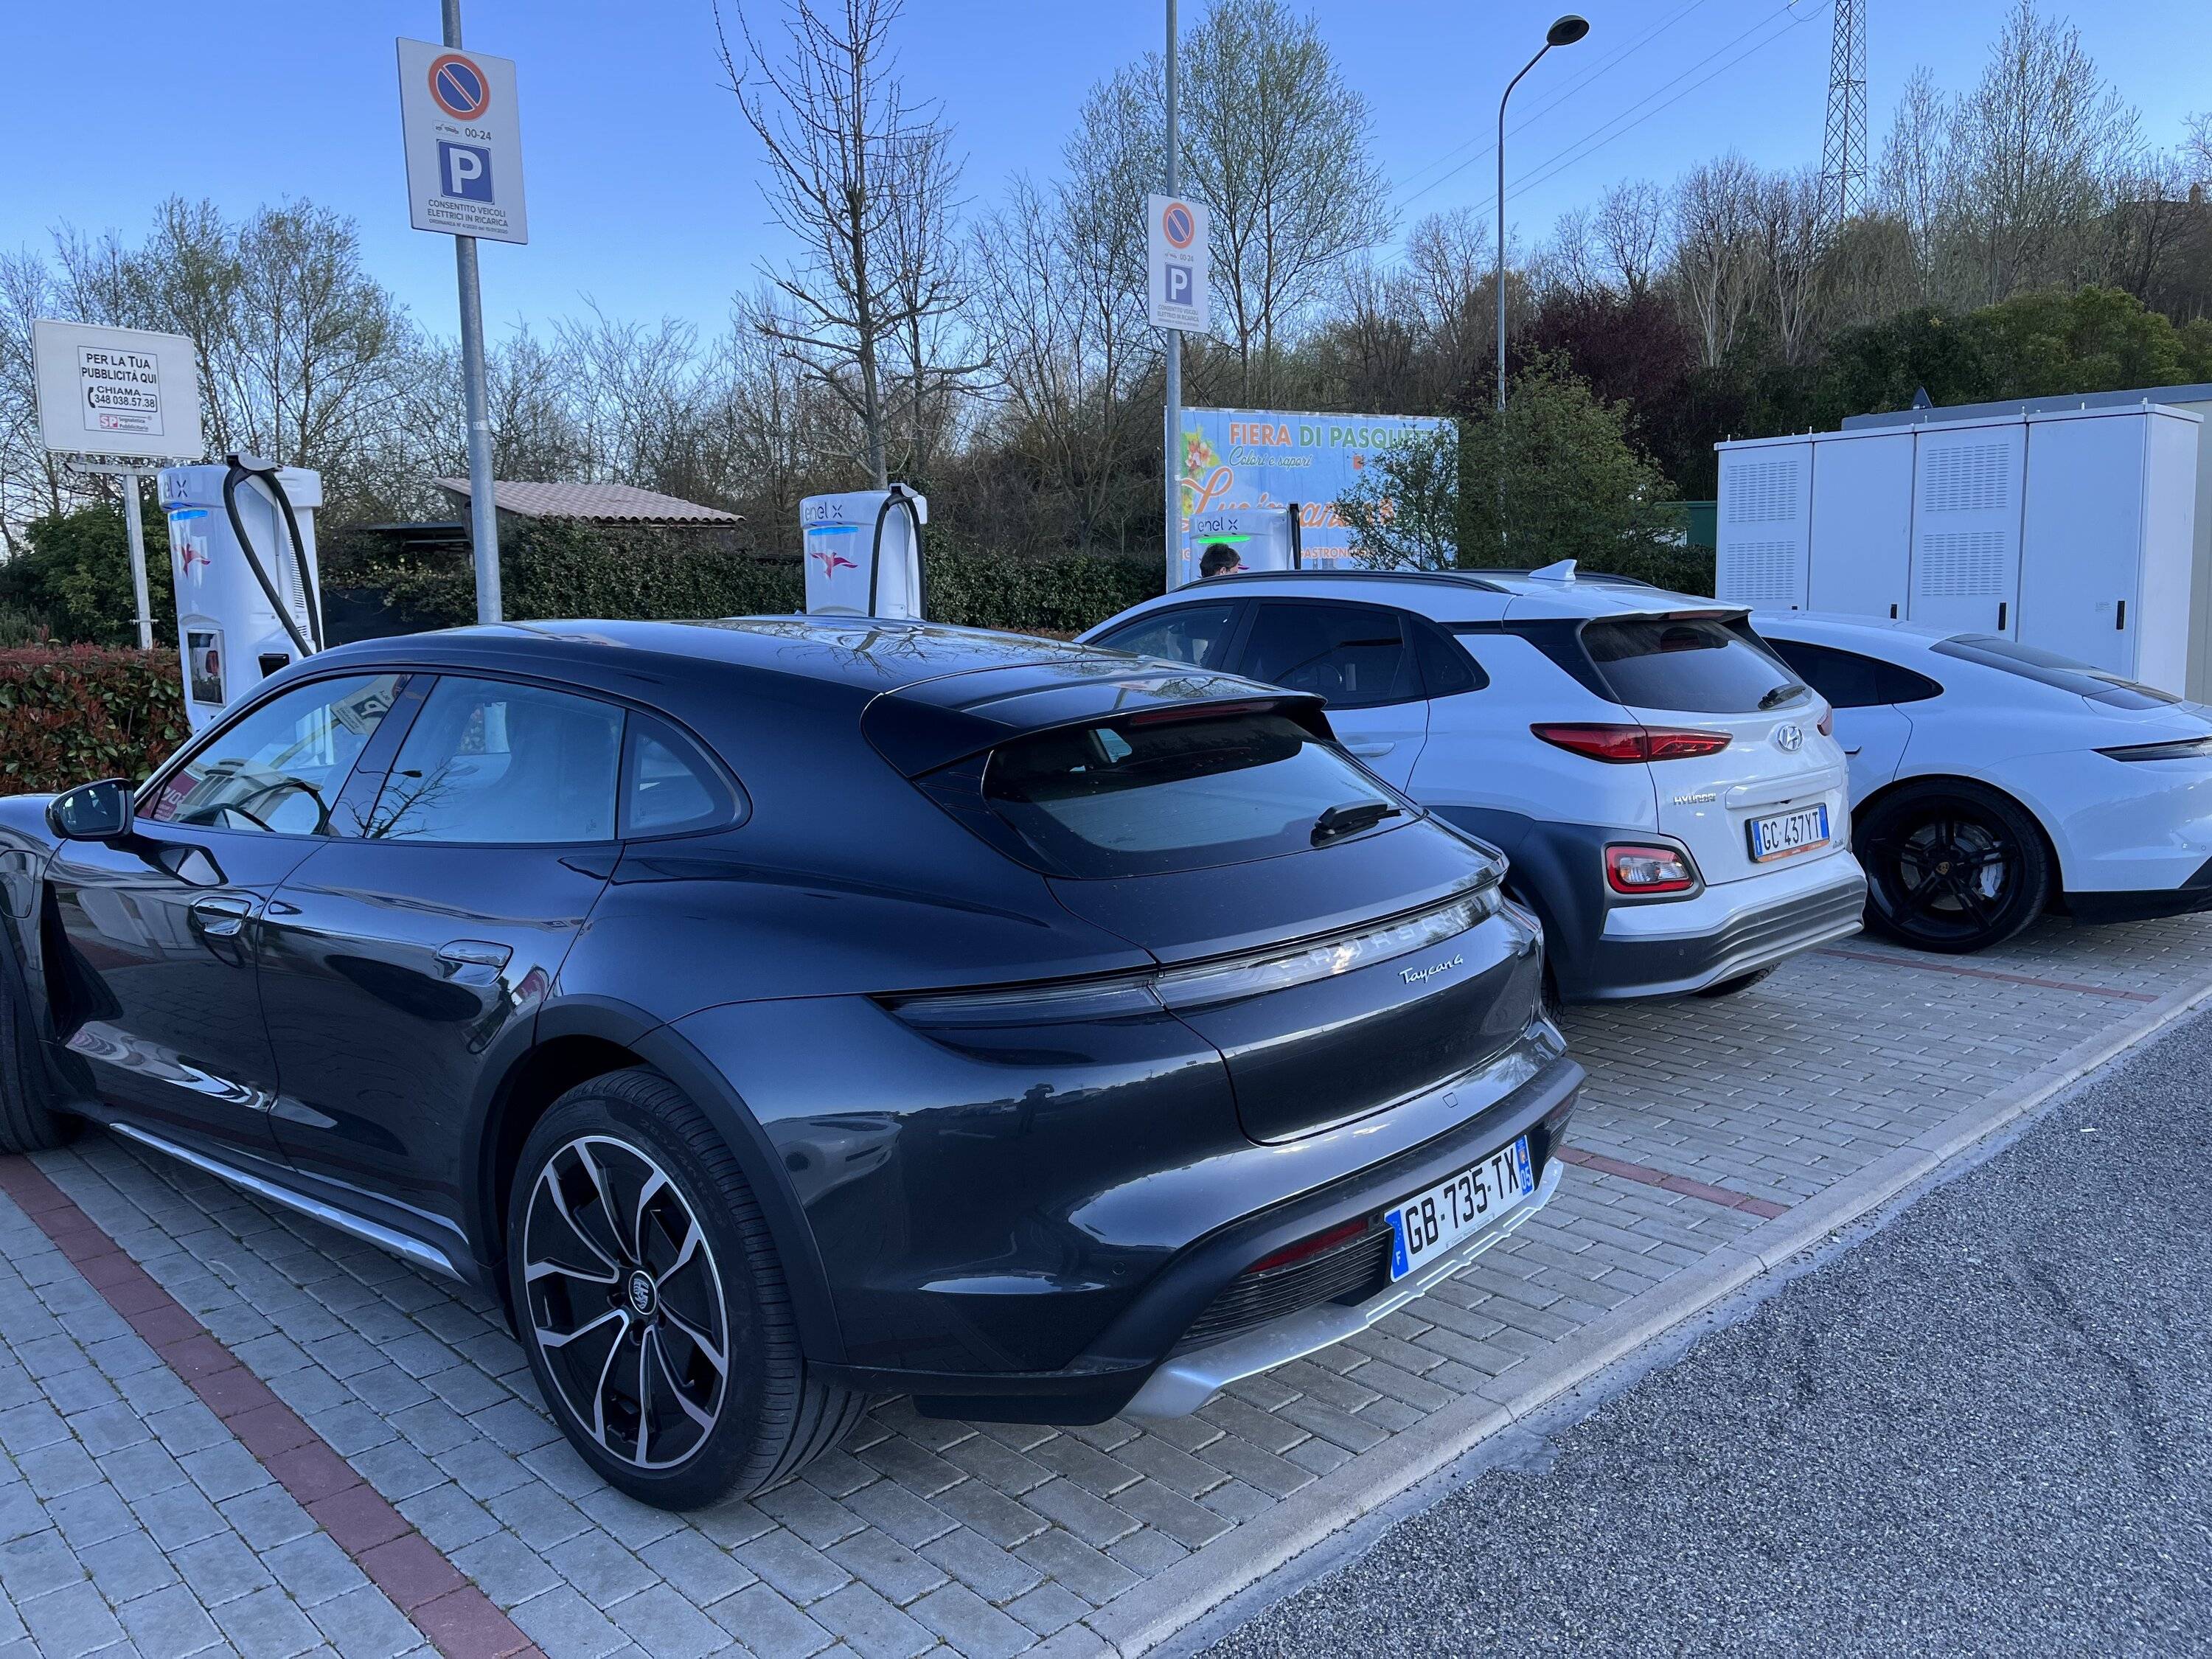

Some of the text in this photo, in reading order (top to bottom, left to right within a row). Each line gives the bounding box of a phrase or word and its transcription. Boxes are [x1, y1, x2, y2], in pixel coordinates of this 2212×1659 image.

[465, 128, 492, 141] 00-24
[449, 147, 481, 193] P
[428, 199, 507, 218] CONSENTITO VEICOLI
[428, 209, 464, 220] ELETTRICI
[475, 215, 508, 227] RICARICA
[1170, 268, 1188, 300] P
[86, 353, 151, 369] PER LA TUA
[81, 366, 157, 384] PUBBLICITÀ QUI
[97, 386, 141, 397] CHIAMA
[94, 394, 155, 408] 348 038.57.38
[1230, 422, 1292, 446] FIERA
[1299, 425, 1321, 447] DI
[1229, 445, 1312, 470] Colori e sapori
[805, 502, 829, 521] enel
[1197, 516, 1224, 532] enel
[1399, 961, 1452, 984] Taycan
[1520, 1166, 1531, 1190] 05
[1395, 1250, 1401, 1266] F
